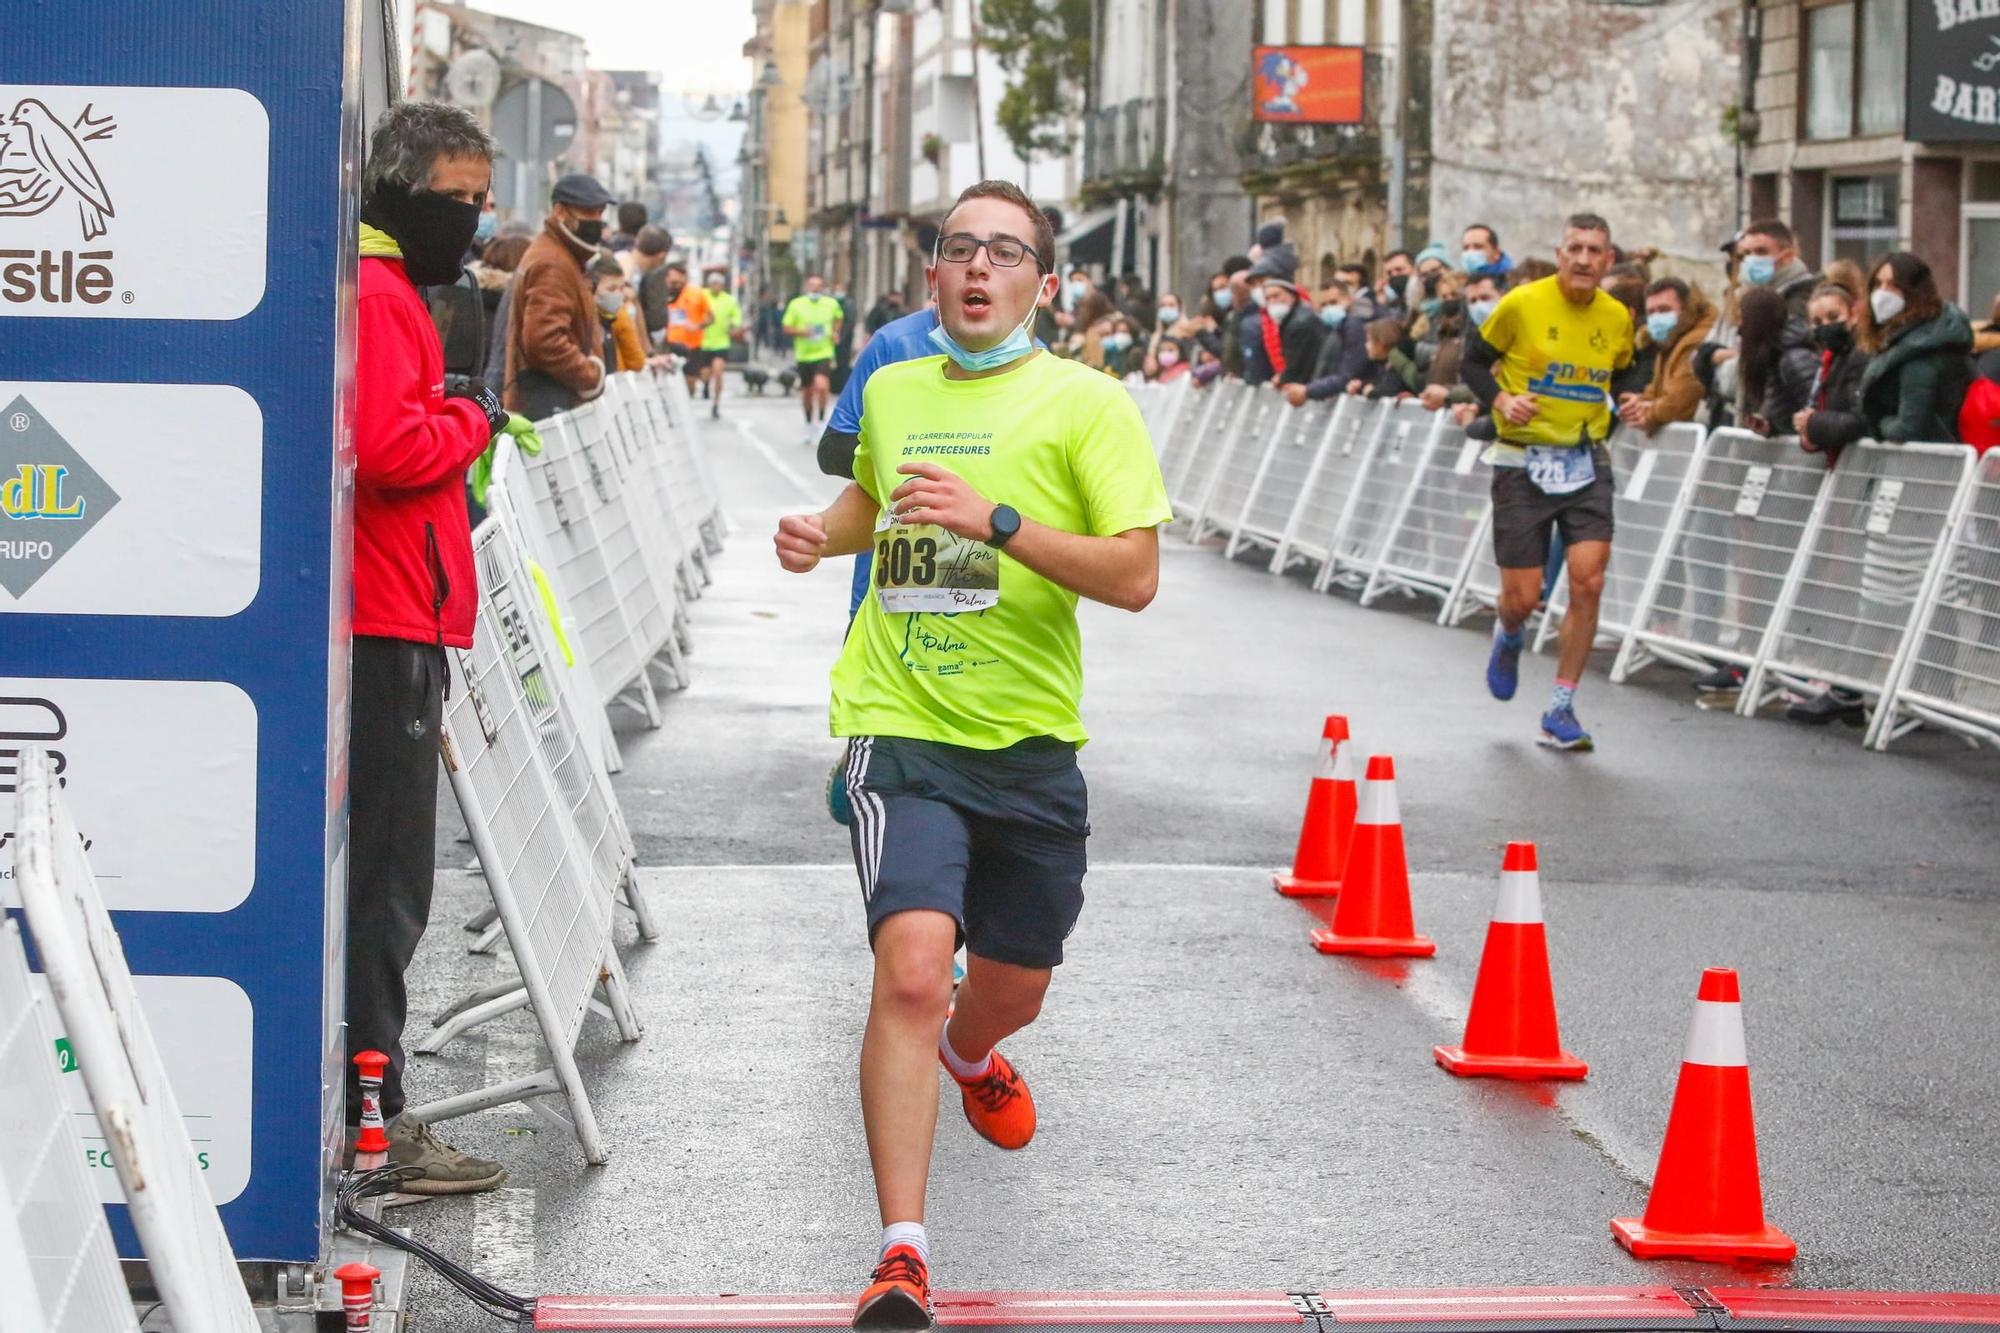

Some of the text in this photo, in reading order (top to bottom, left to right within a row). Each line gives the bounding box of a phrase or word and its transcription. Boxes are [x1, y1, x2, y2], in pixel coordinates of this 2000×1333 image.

[1930, 74, 2000, 125] BAR
[0, 250, 114, 304] stlé
[902, 445, 991, 455] DE PONTECESURES
[919, 432, 955, 440] CARREIRA
[956, 432, 993, 440] POPULAR
[0, 464, 86, 520] dL
[0, 540, 53, 561] RUPO
[877, 537, 937, 587] 303
[922, 635, 968, 653] Palma
